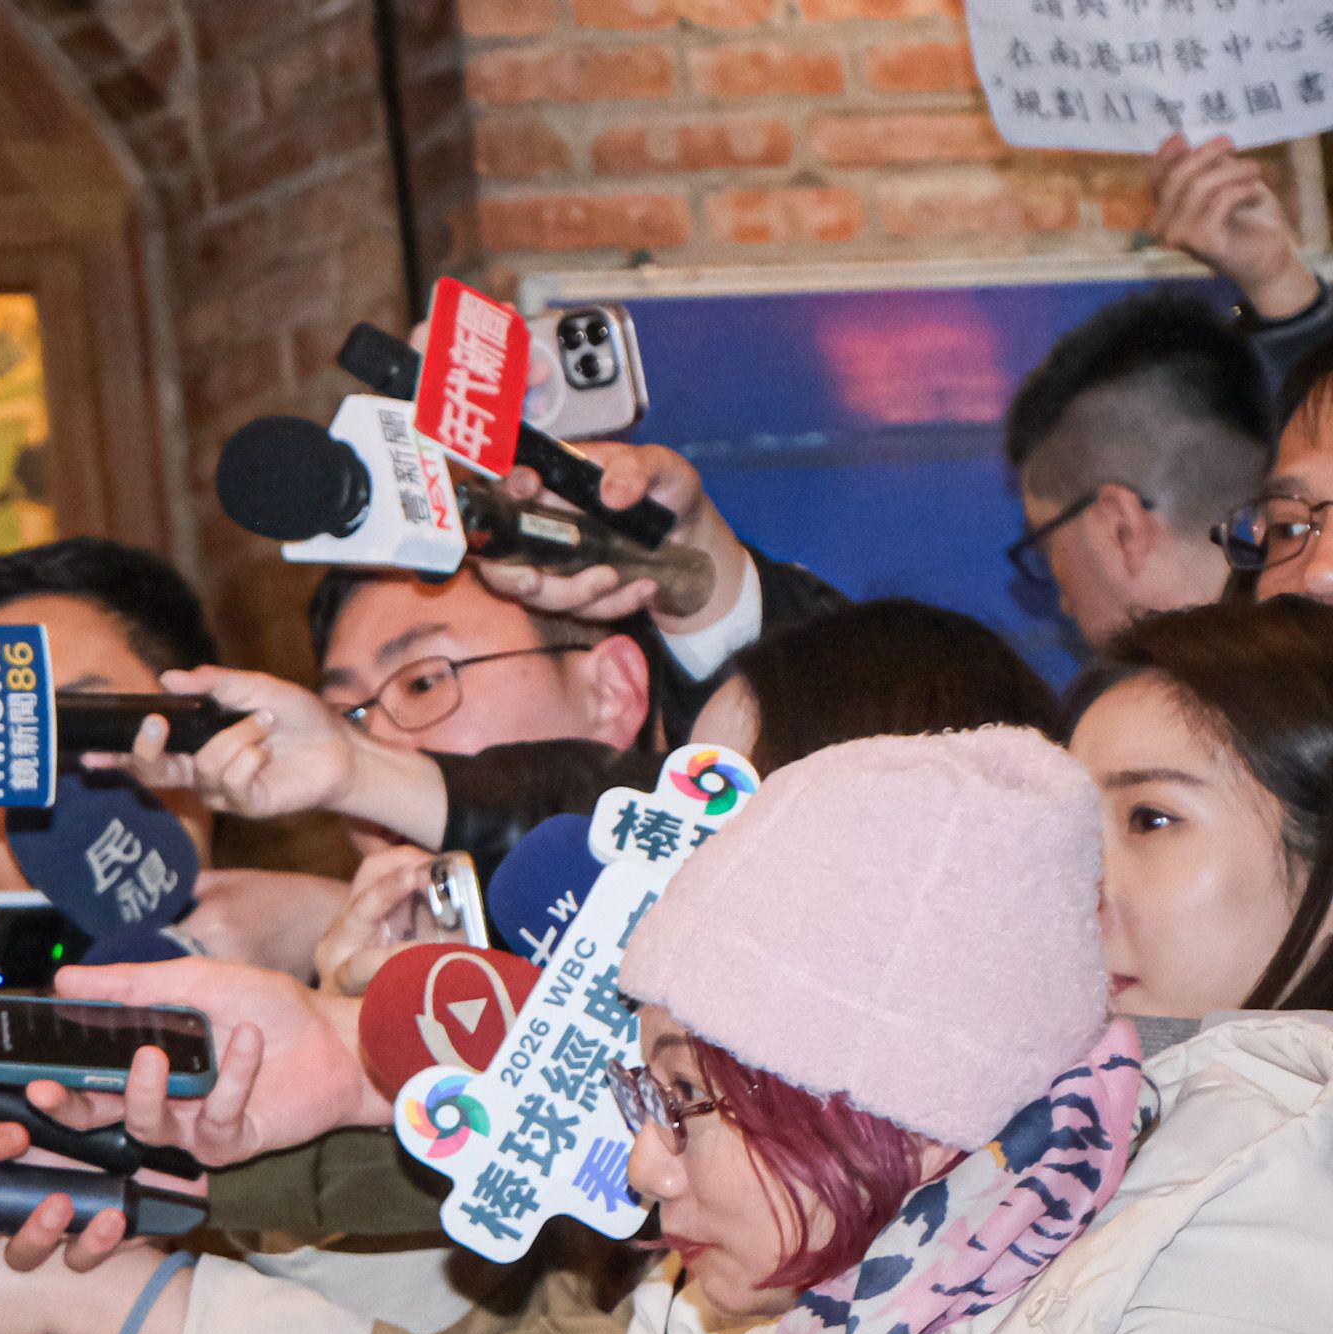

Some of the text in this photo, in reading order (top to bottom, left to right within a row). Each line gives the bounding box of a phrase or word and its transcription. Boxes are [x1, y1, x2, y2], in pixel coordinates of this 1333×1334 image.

[86, 816, 179, 923] 民視
[500, 1016, 552, 1088] 2026
[543, 935, 598, 1008] WBC
